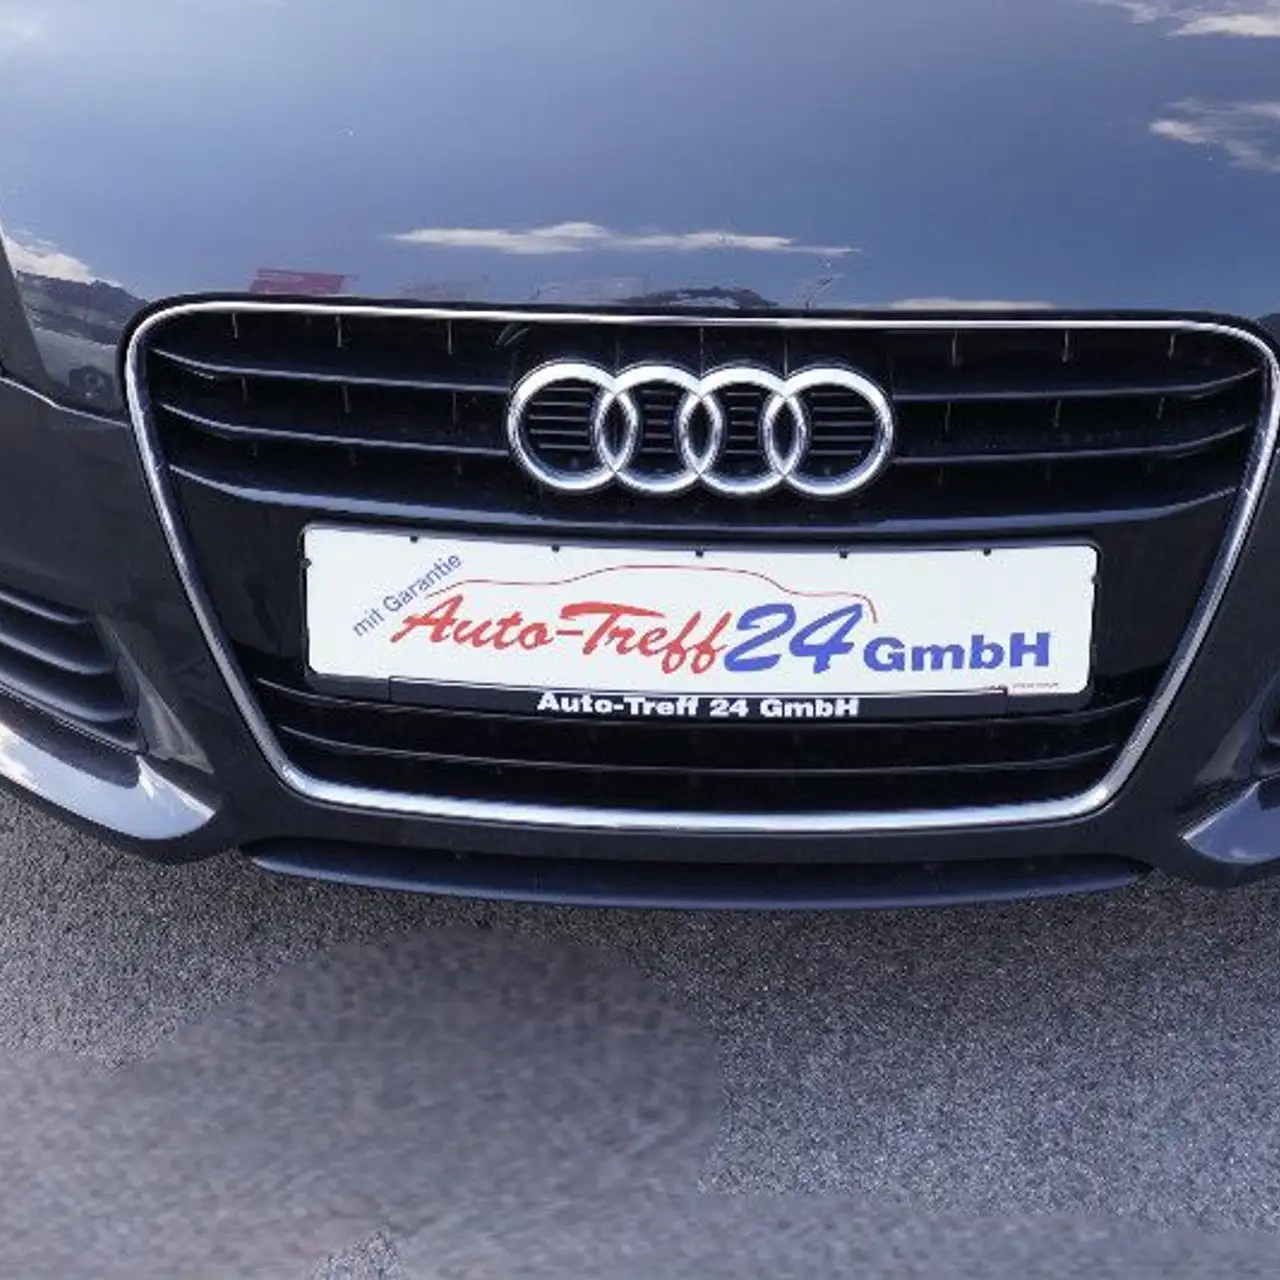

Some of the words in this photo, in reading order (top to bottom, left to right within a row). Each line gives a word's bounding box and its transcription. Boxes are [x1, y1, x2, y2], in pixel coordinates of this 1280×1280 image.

[353, 608, 385, 637] mit
[382, 555, 462, 612] Garantie
[863, 632, 1051, 672] GmbH
[536, 692, 698, 716] Auto-Treff
[709, 696, 748, 717] 24
[760, 699, 859, 717] GmbH
